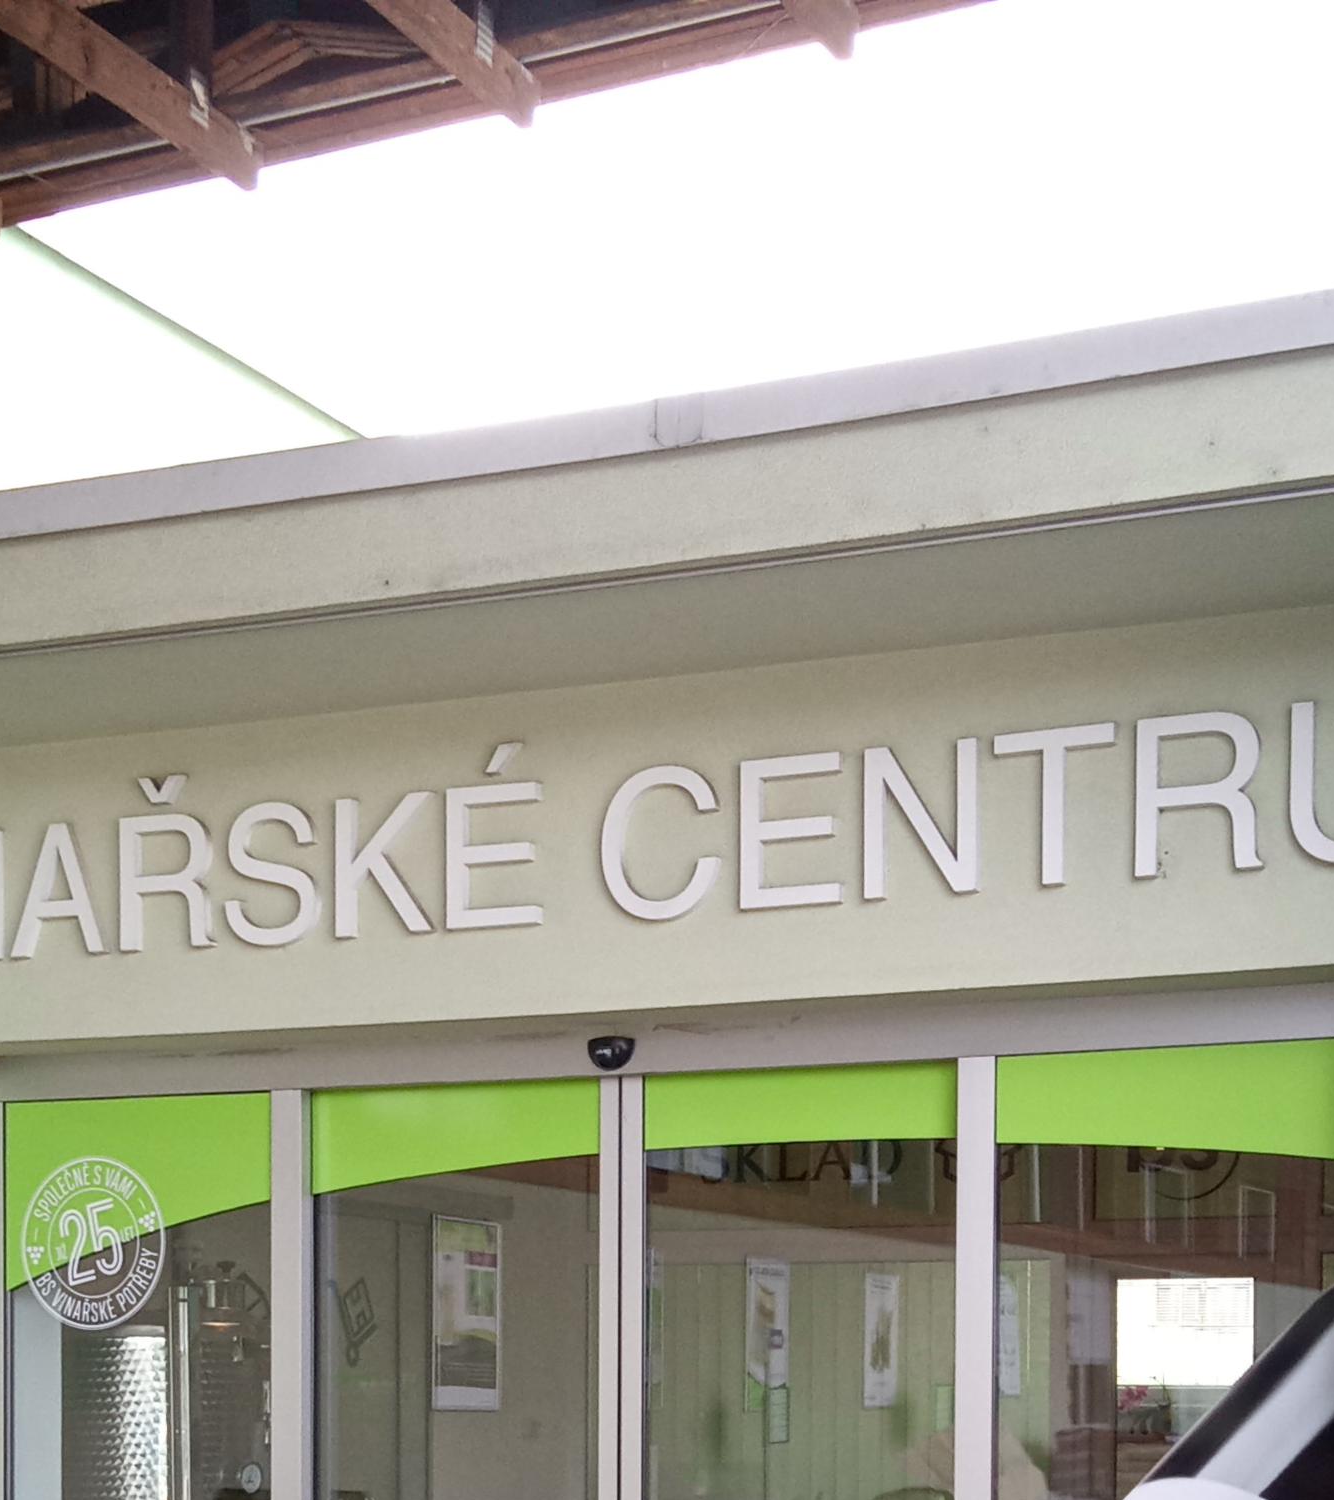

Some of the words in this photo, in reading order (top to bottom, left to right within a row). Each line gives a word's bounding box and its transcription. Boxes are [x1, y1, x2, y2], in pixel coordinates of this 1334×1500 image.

[34, 1162, 89, 1221] SPOLEČNĚ
[93, 1165, 103, 1185] S
[105, 1164, 138, 1200] VÁMI
[59, 1198, 124, 1286] 25
[36, 1272, 57, 1297] BS
[51, 1289, 117, 1323] VINAŘSKÉ
[116, 1248, 159, 1312] POTŘEBY
